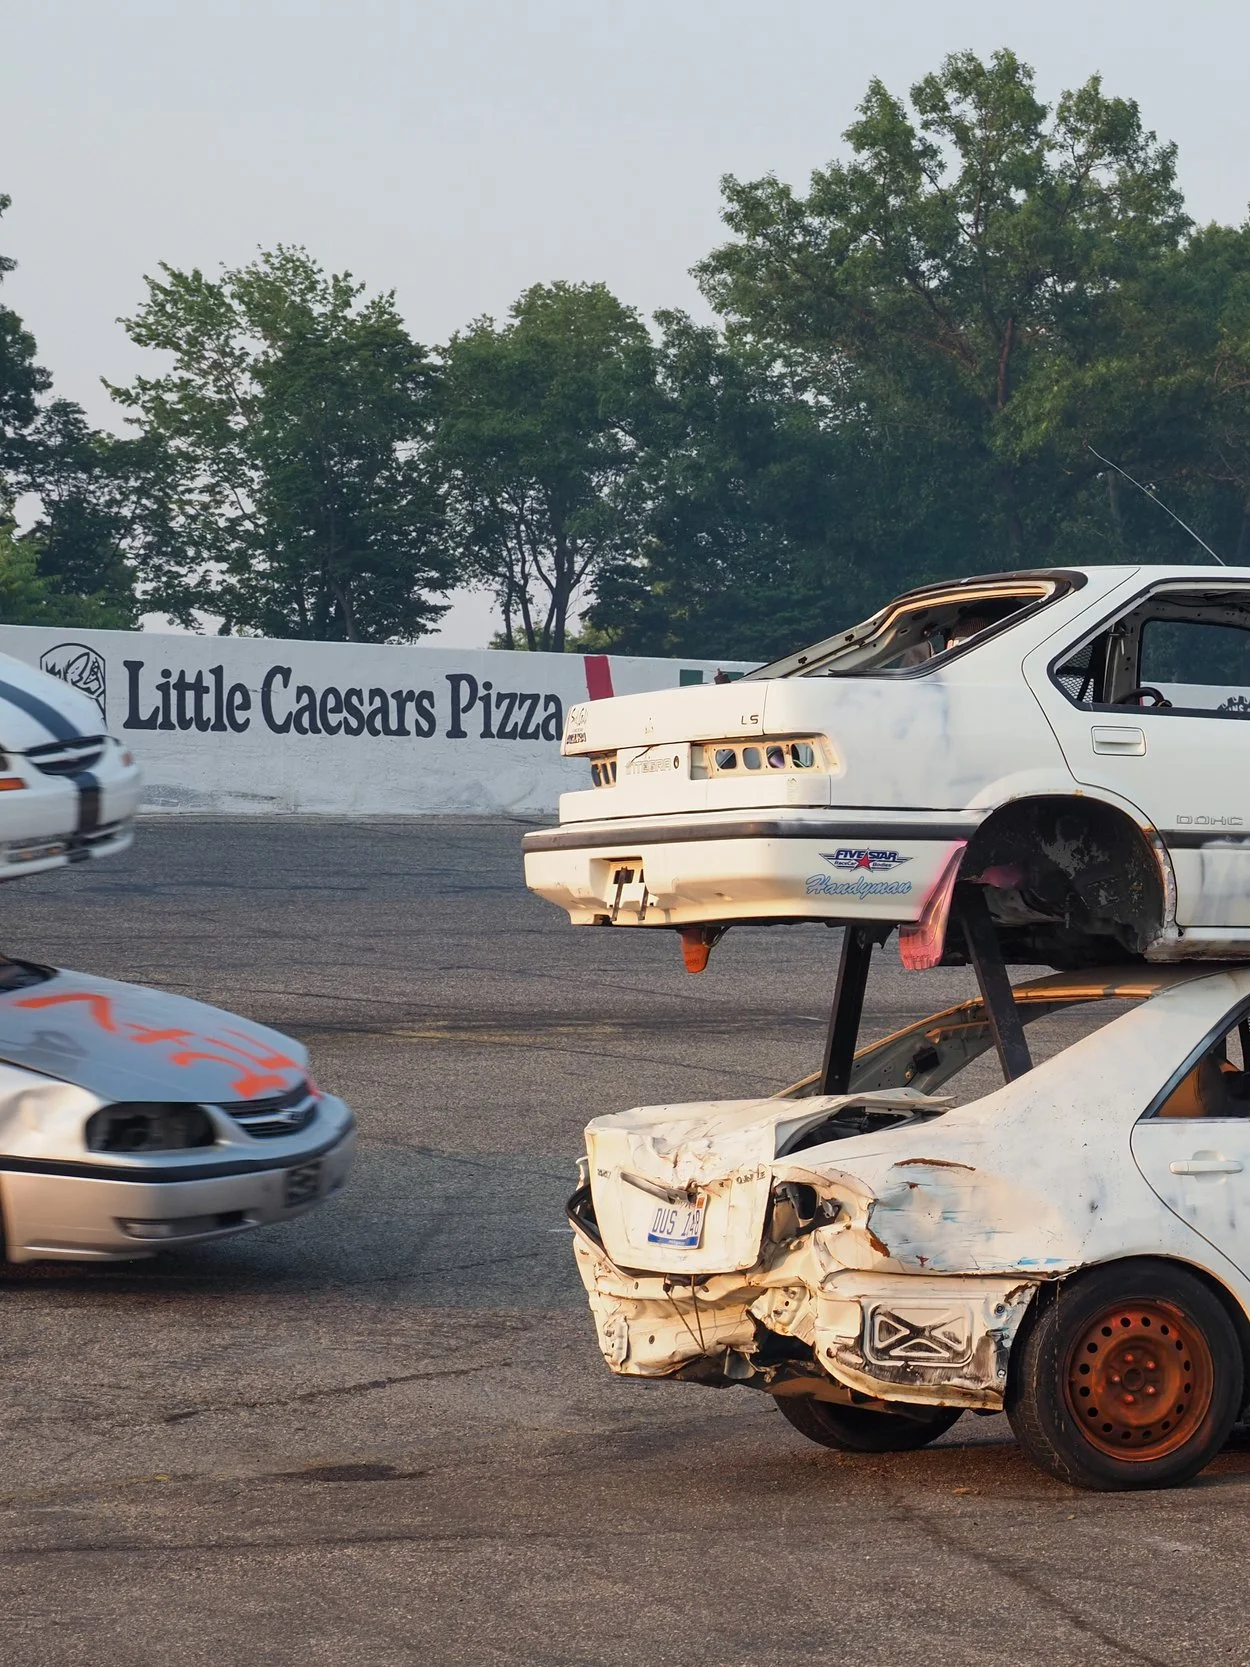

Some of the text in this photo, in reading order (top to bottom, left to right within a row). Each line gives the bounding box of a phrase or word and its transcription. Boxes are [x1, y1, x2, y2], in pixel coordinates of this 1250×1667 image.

[122, 659, 564, 741] Little Caesars Pizza
[836, 850, 897, 861] FIVE STAR
[805, 873, 912, 900] Handyman
[651, 1207, 678, 1235] DUS
